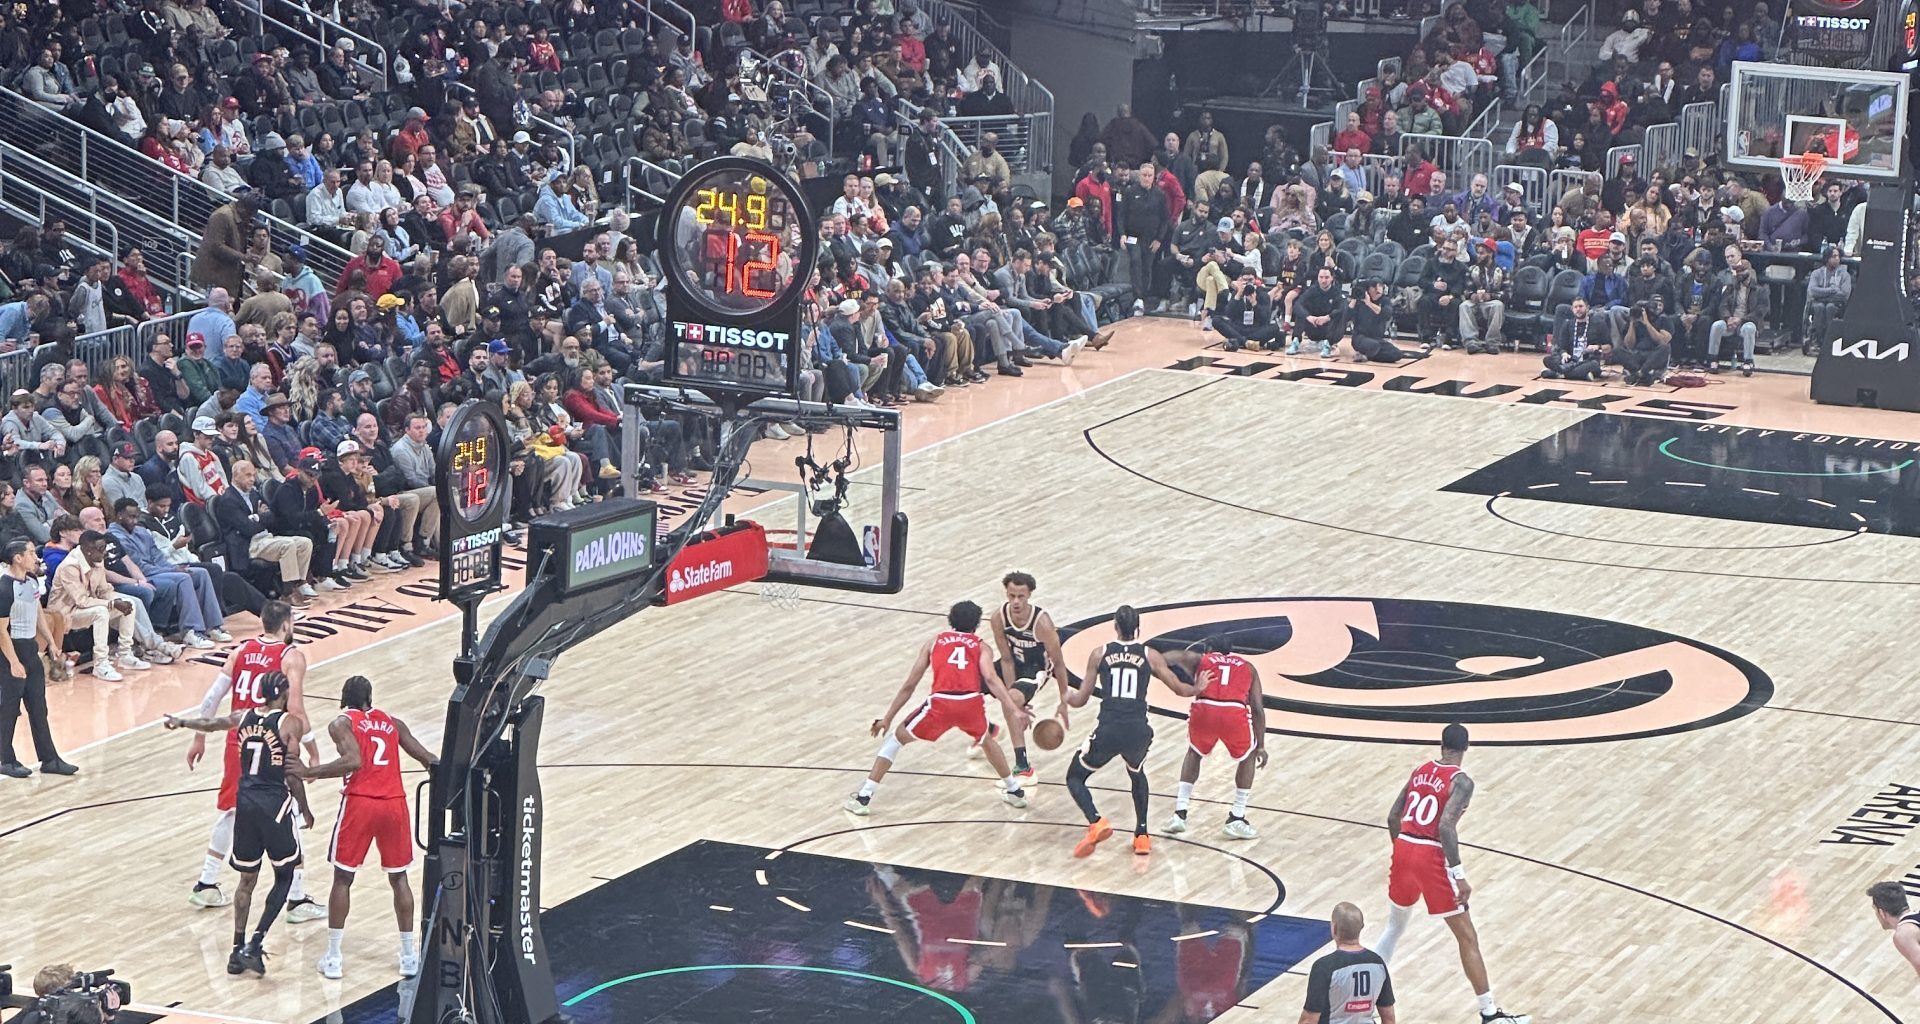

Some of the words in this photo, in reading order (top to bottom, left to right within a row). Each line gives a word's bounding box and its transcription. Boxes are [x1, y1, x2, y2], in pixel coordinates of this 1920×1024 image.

[1816, 17, 1870, 30] TISSOT
[695, 189, 768, 230] 24.9
[726, 231, 779, 299] 12
[704, 325, 789, 351] TISSOT
[1164, 356, 1738, 421] HAWKS
[1697, 423, 1776, 438] CITY
[467, 467, 489, 508] 12
[465, 527, 502, 551] TISSOT
[947, 646, 969, 670] 4
[1105, 652, 1145, 668] RISACHER
[1110, 667, 1138, 699] 10
[1218, 664, 1231, 686] 1
[246, 741, 264, 775] 7
[370, 735, 389, 766] 2
[1413, 773, 1445, 793] COLLINS
[1402, 790, 1439, 826] 20
[520, 795, 536, 966] ticketmaster
[1352, 970, 1371, 997] 10
